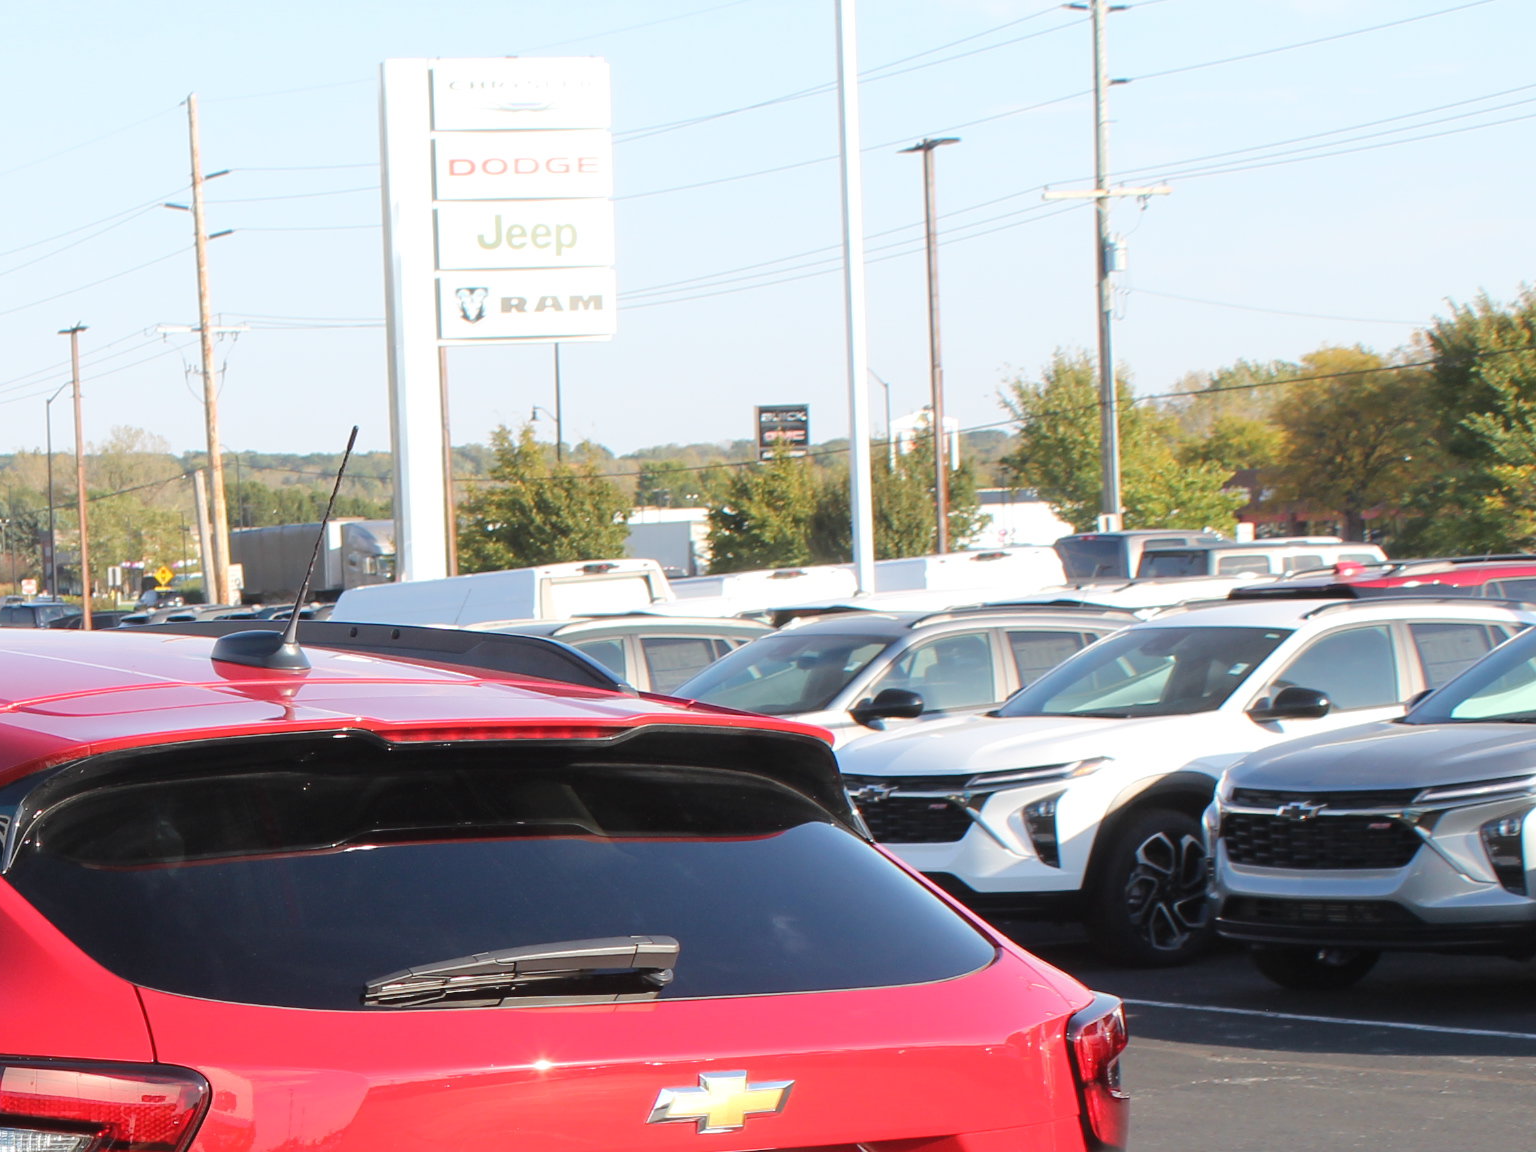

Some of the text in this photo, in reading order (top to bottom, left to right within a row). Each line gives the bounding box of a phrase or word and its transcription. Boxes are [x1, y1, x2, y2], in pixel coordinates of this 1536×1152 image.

[448, 157, 601, 177] DODGE
[476, 214, 578, 256] Jeep
[500, 294, 604, 313] RAM
